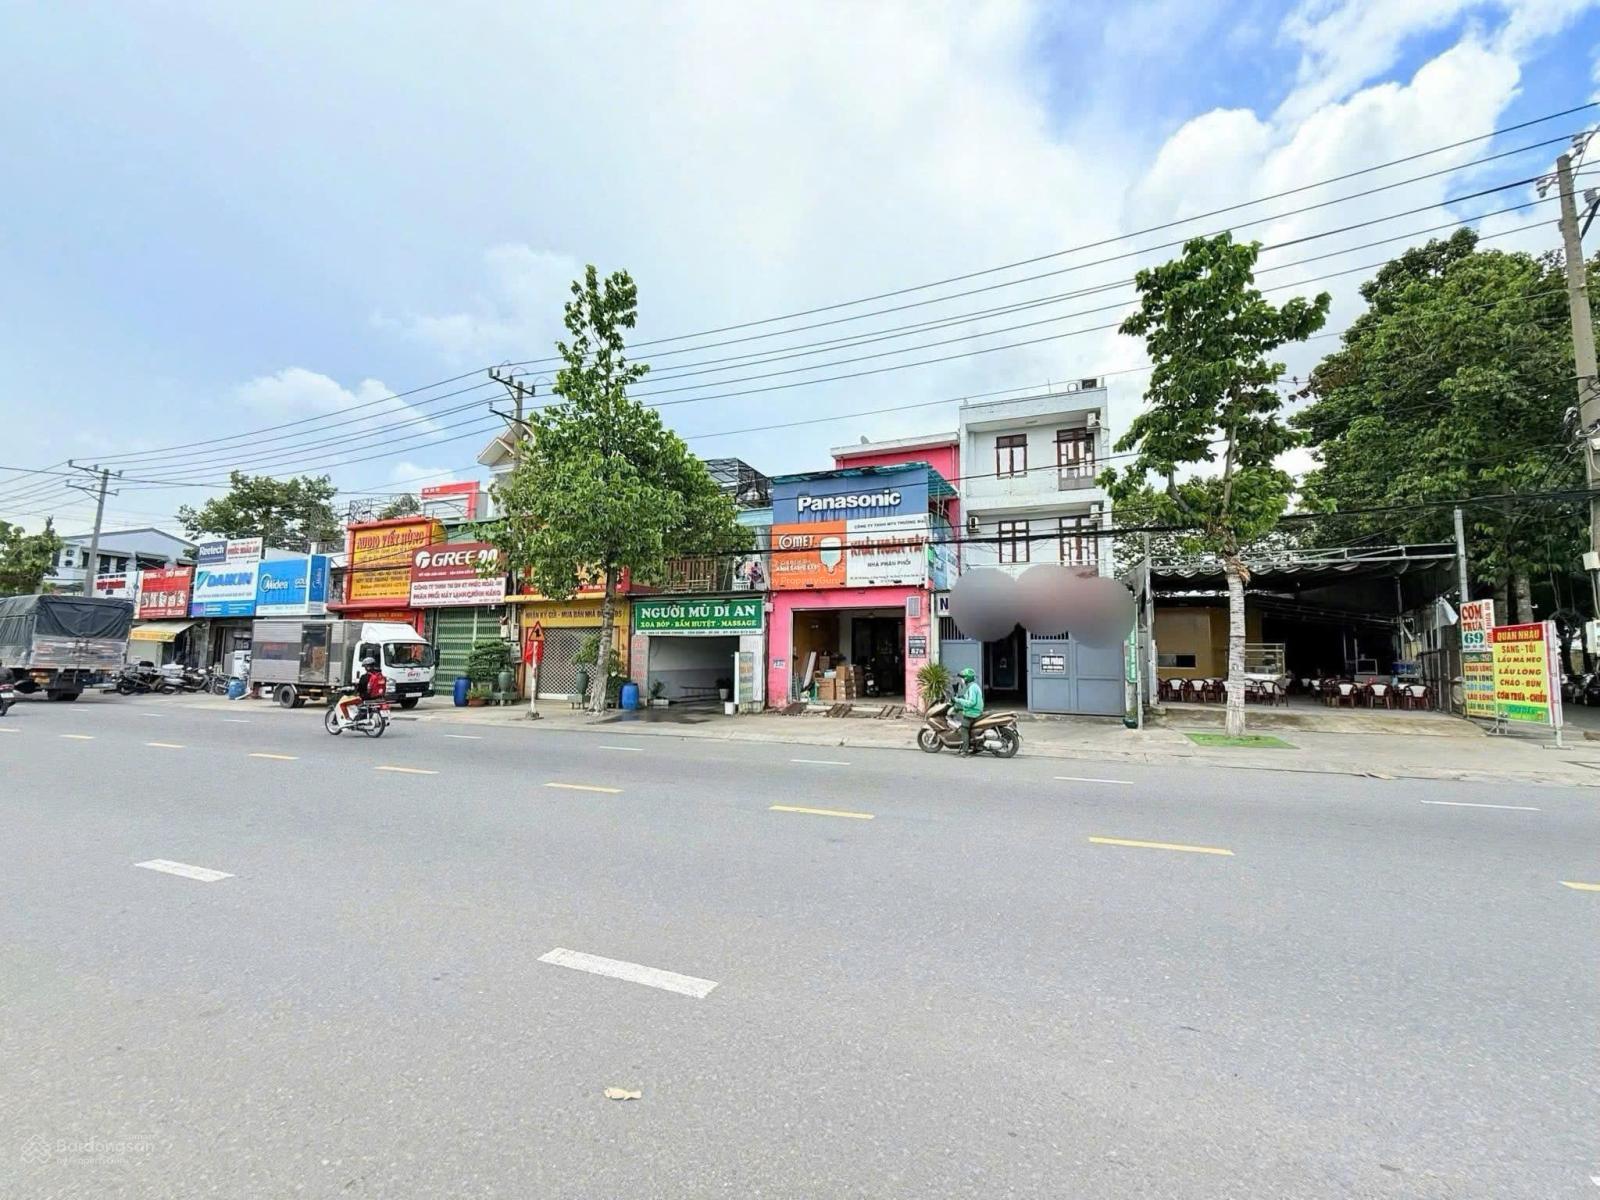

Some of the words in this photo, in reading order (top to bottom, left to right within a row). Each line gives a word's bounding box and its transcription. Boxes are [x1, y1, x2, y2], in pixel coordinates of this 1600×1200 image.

[798, 489, 902, 512] Panasonic
[199, 545, 225, 556] Reetech
[431, 549, 477, 567] GREE
[206, 572, 254, 587] DAIKIN
[641, 603, 685, 618] NGƯỜI
[688, 603, 710, 618] MÙ
[734, 605, 757, 617] AN
[1461, 603, 1483, 621] CƠM
[640, 620, 655, 628] XOA
[656, 619, 669, 628] BÓP
[675, 618, 691, 628] BẤM
[691, 619, 716, 628] HUYỆT
[721, 619, 757, 628] MASSAGE
[1462, 621, 1483, 632] TRƯA
[1464, 632, 1484, 644] 69
[1497, 628, 1518, 641] QUÁN
[1518, 626, 1540, 640] NHẬU
